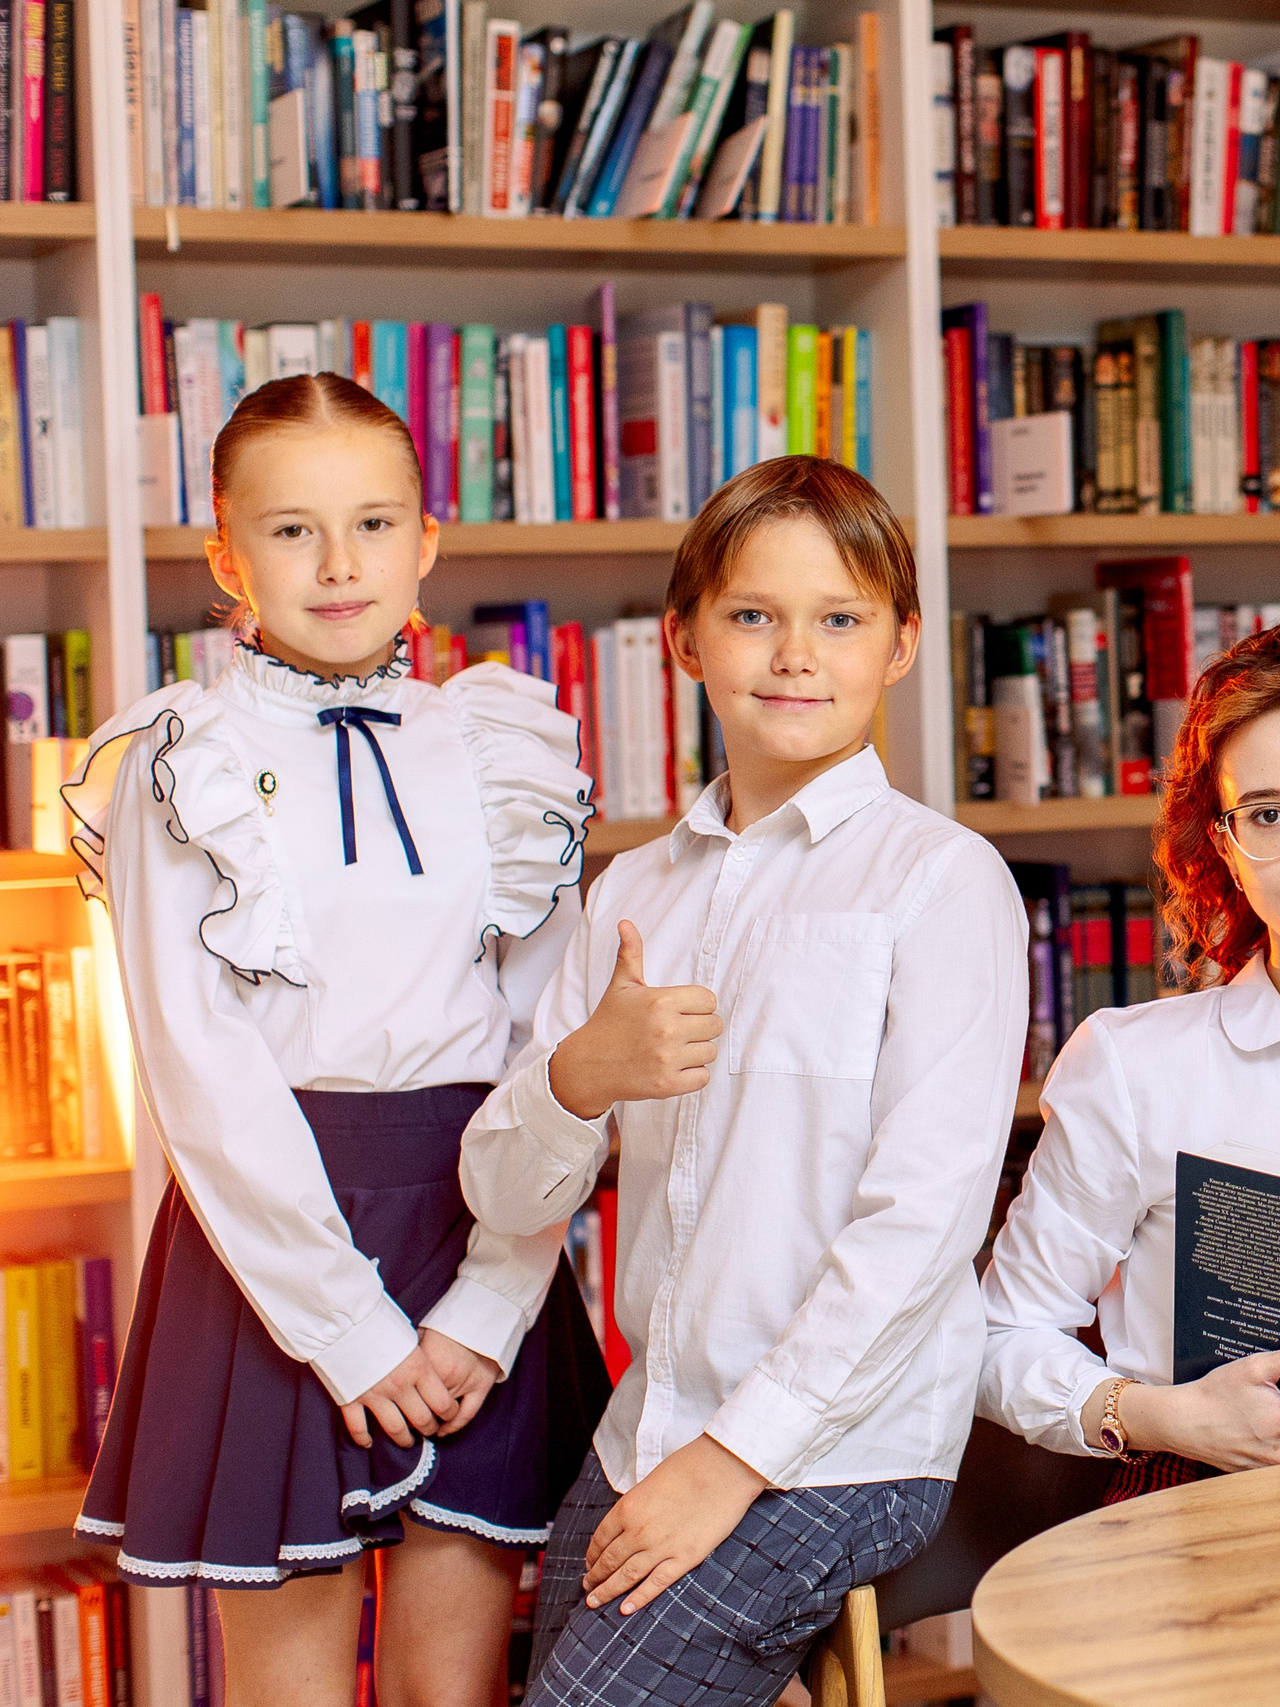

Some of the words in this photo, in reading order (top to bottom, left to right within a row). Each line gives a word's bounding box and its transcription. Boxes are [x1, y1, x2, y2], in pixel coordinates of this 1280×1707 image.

[1203, 1311, 1224, 1321] Сименон
[1230, 1317, 1246, 1327] редкий
[1247, 1323, 1262, 1332] мастер
[1208, 1332, 1220, 1340] книгу
[1221, 1336, 1236, 1344] вошли
[1219, 1343, 1246, 1356] Пассажир
